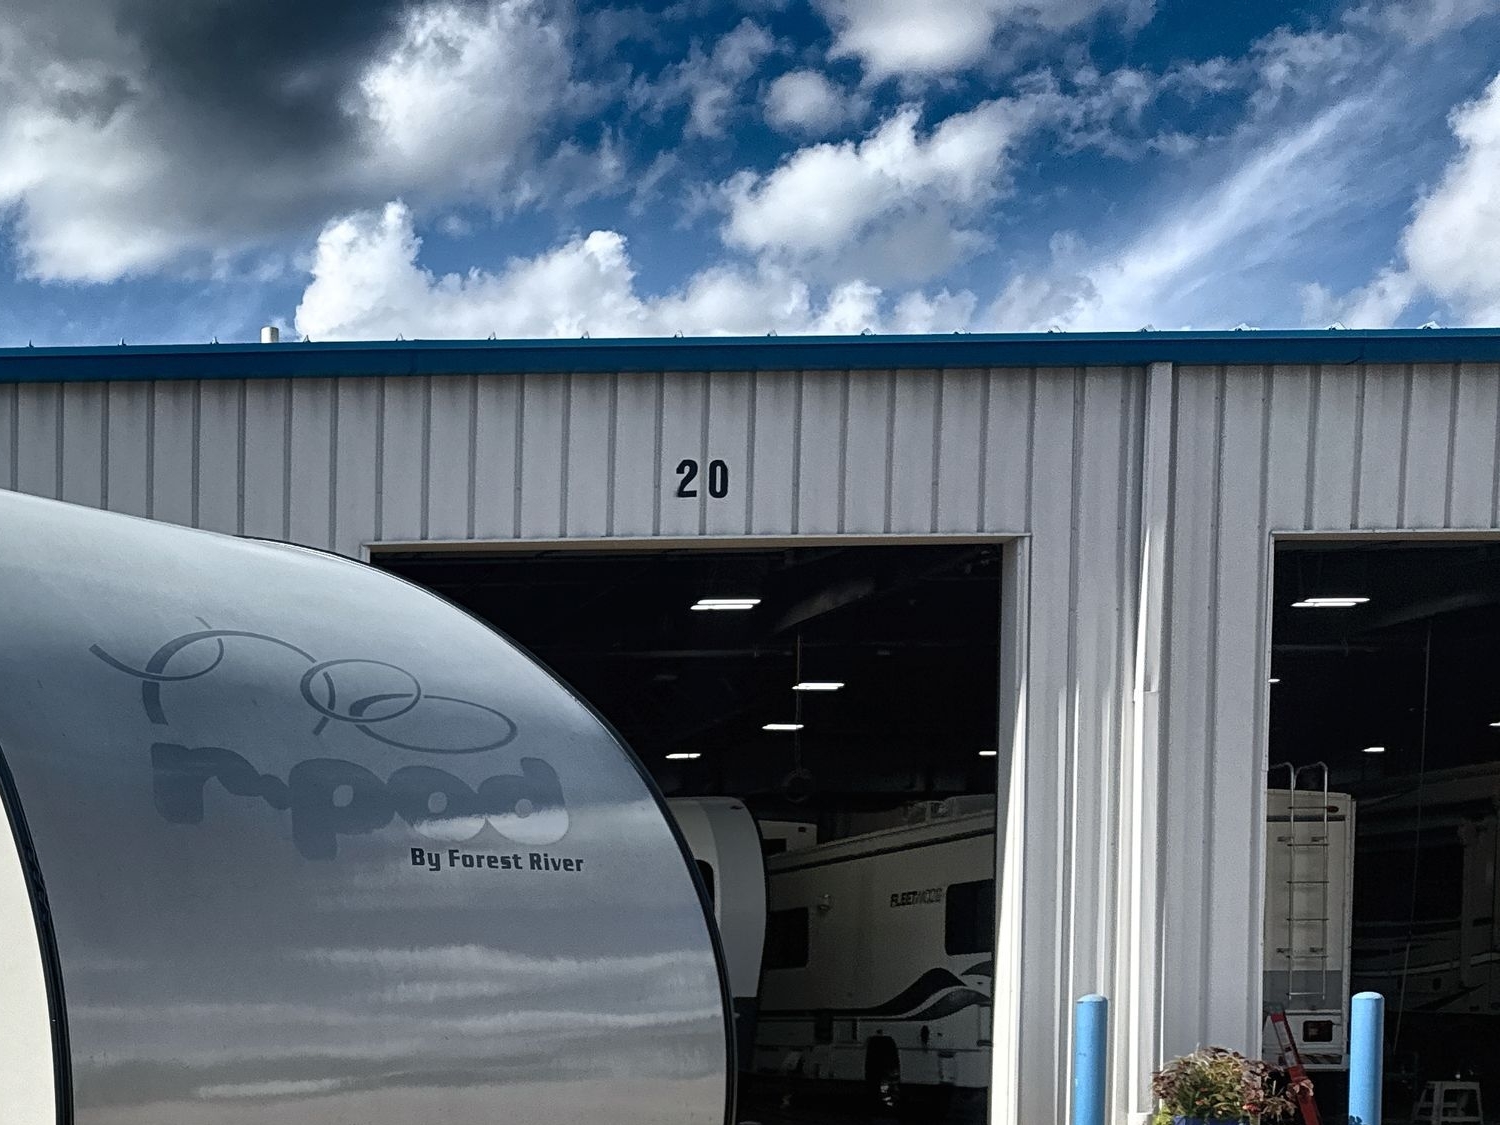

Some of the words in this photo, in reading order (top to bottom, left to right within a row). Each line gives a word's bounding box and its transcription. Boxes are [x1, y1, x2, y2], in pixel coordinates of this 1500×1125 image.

[676, 459, 728, 498] 20
[410, 847, 441, 871] By
[448, 849, 523, 869] Forest
[529, 853, 584, 871] River
